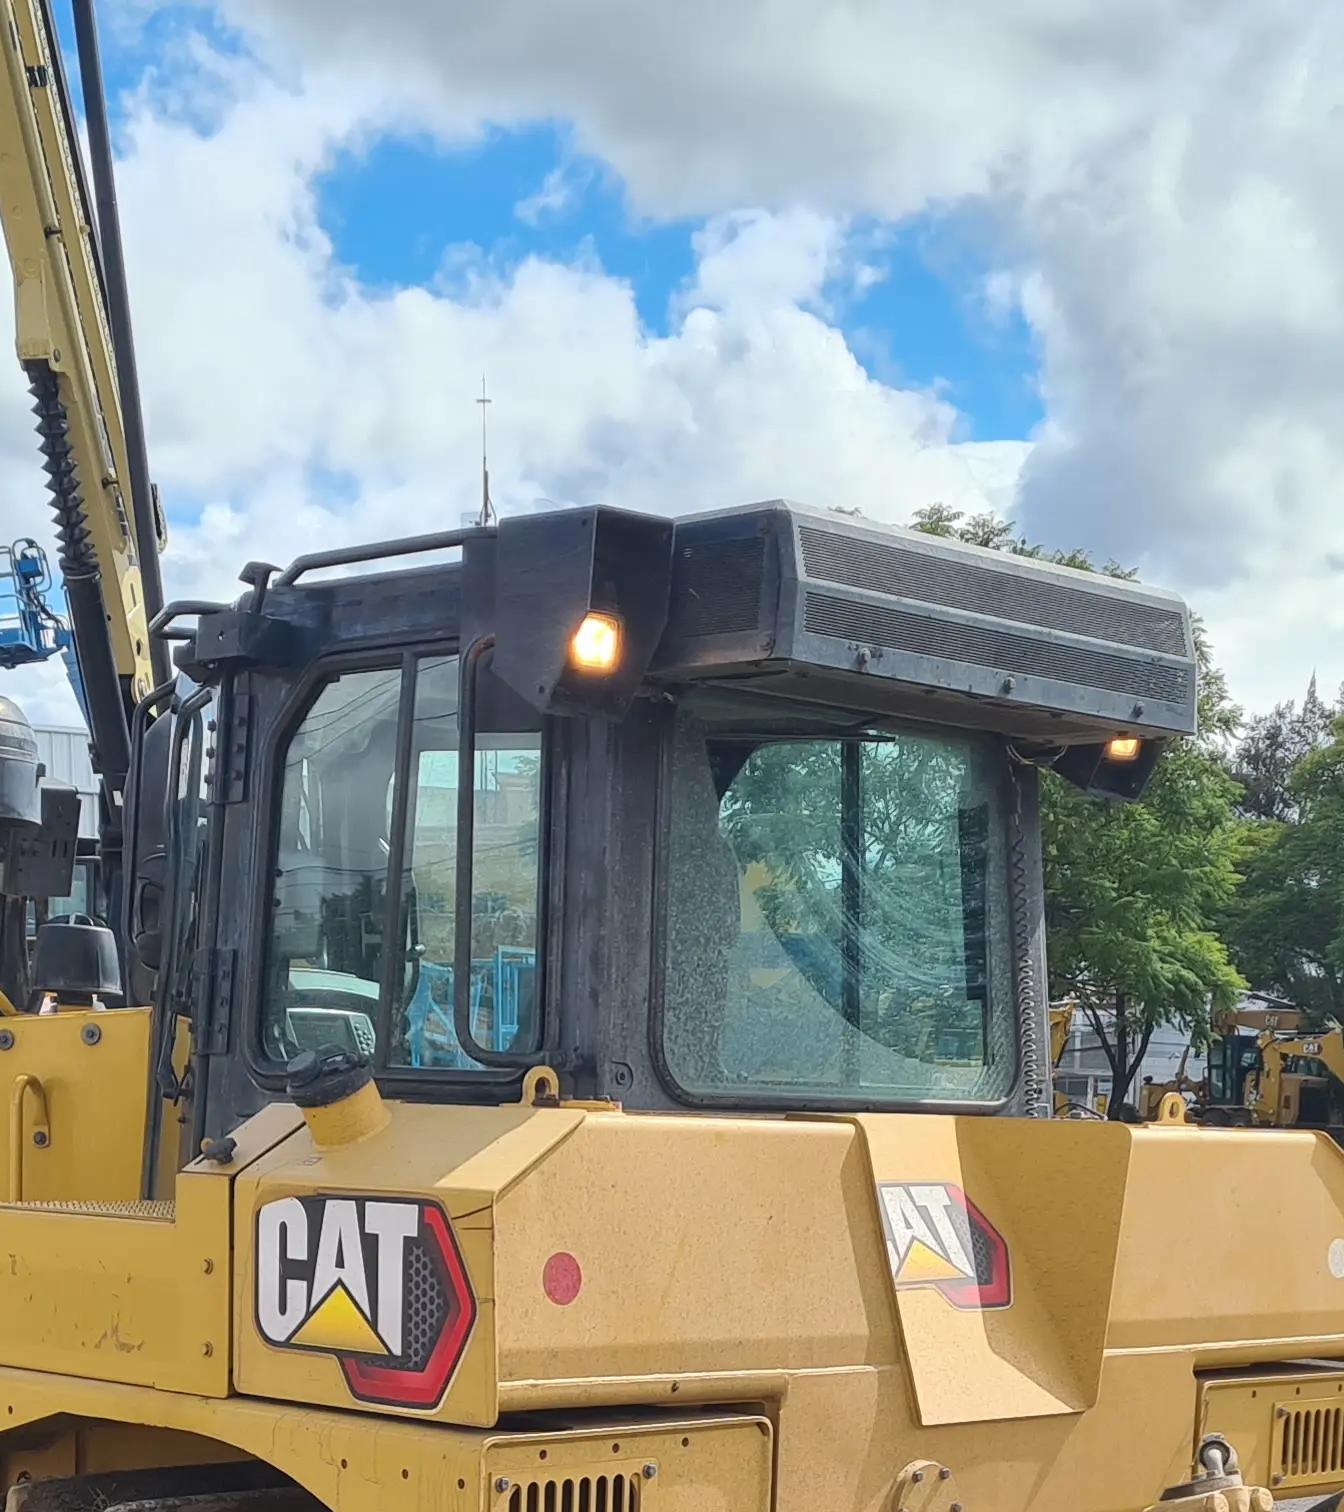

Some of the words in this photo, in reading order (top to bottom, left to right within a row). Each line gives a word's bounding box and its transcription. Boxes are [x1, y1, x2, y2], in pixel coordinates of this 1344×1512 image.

[1265, 1015, 1280, 1027] CAT
[1303, 1043, 1319, 1054] CAT
[881, 1185, 977, 1279] AT
[258, 1197, 419, 1357] CAT
